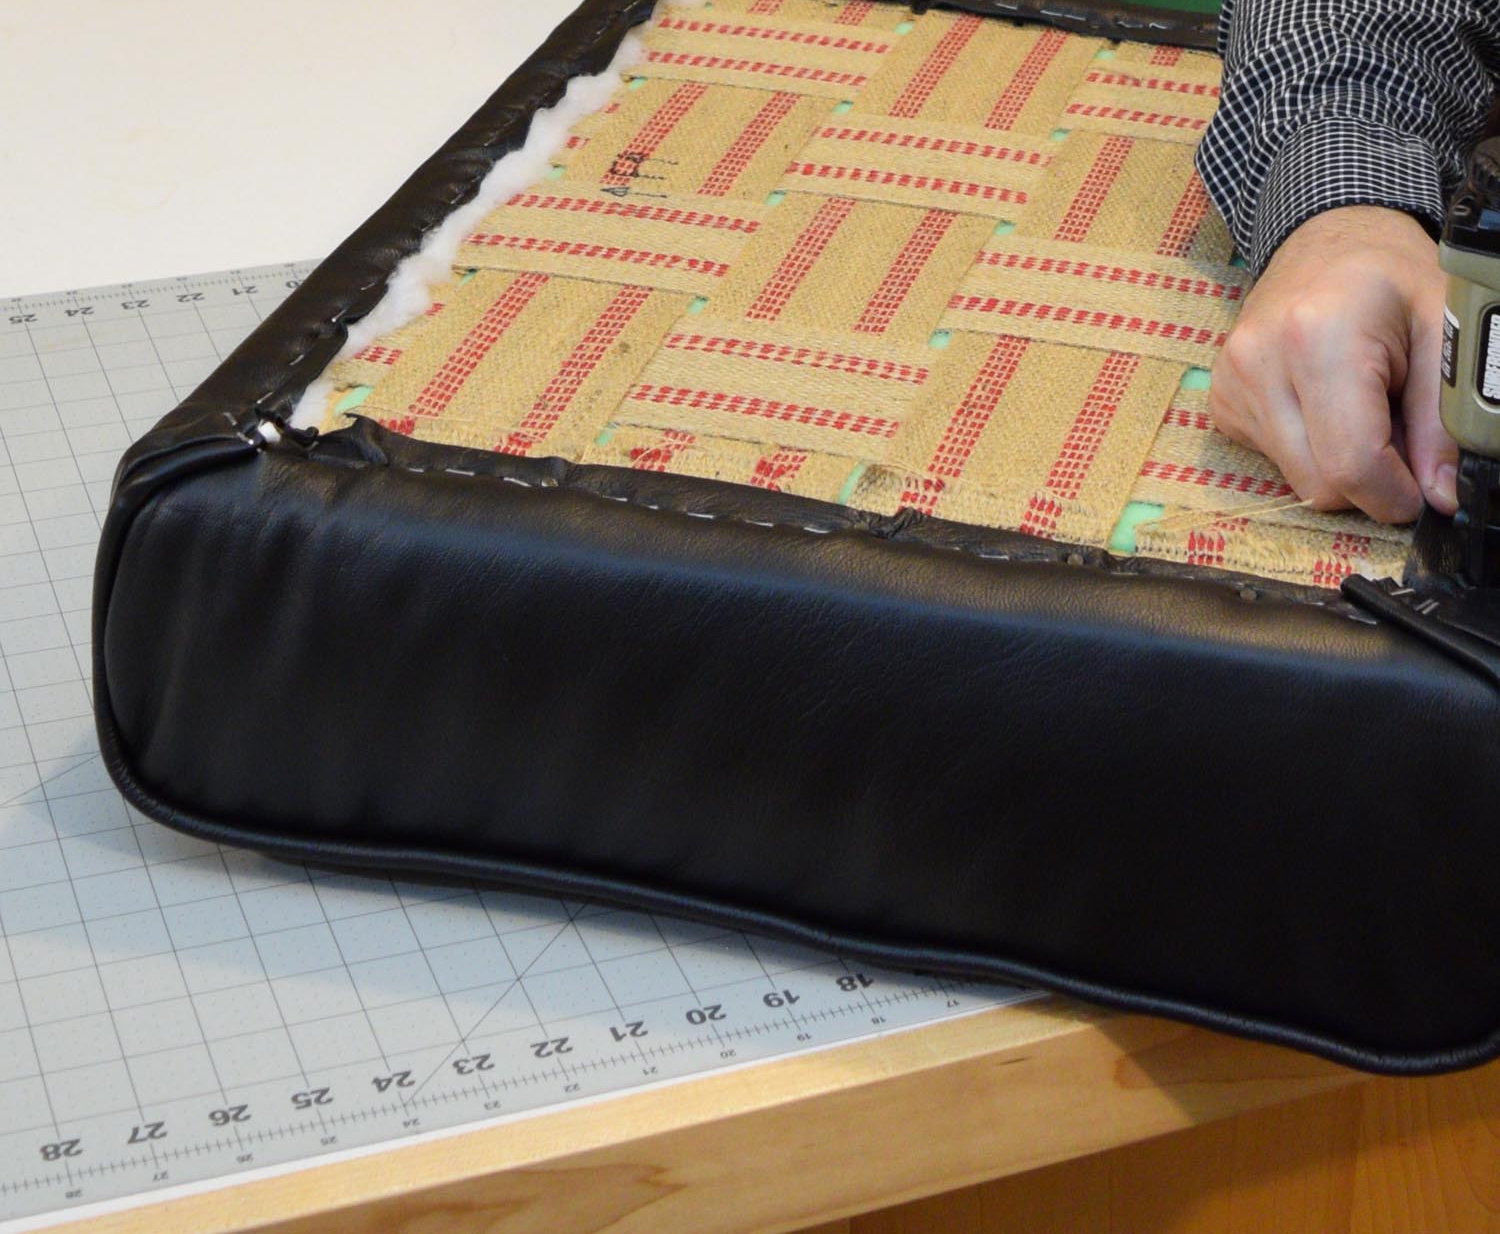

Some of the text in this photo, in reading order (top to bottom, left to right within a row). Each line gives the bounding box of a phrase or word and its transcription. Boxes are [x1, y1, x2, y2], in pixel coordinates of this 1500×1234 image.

[232, 285, 258, 296] 21
[176, 292, 205, 303] 22
[120, 299, 150, 310] 23
[64, 306, 95, 318] 24
[8, 313, 38, 325] 25
[797, 1033, 812, 1042] 19
[720, 1049, 737, 1059] 20
[39, 973, 874, 1162] 18 19 20 21 22 23 24 25 26 27 28
[642, 1066, 659, 1076] 21
[563, 1082, 581, 1093] 22
[483, 1099, 501, 1110] 23
[402, 1117, 420, 1128] 24
[320, 1135, 338, 1146] 25
[235, 1153, 254, 1164] 26
[152, 1170, 169, 1181] 27
